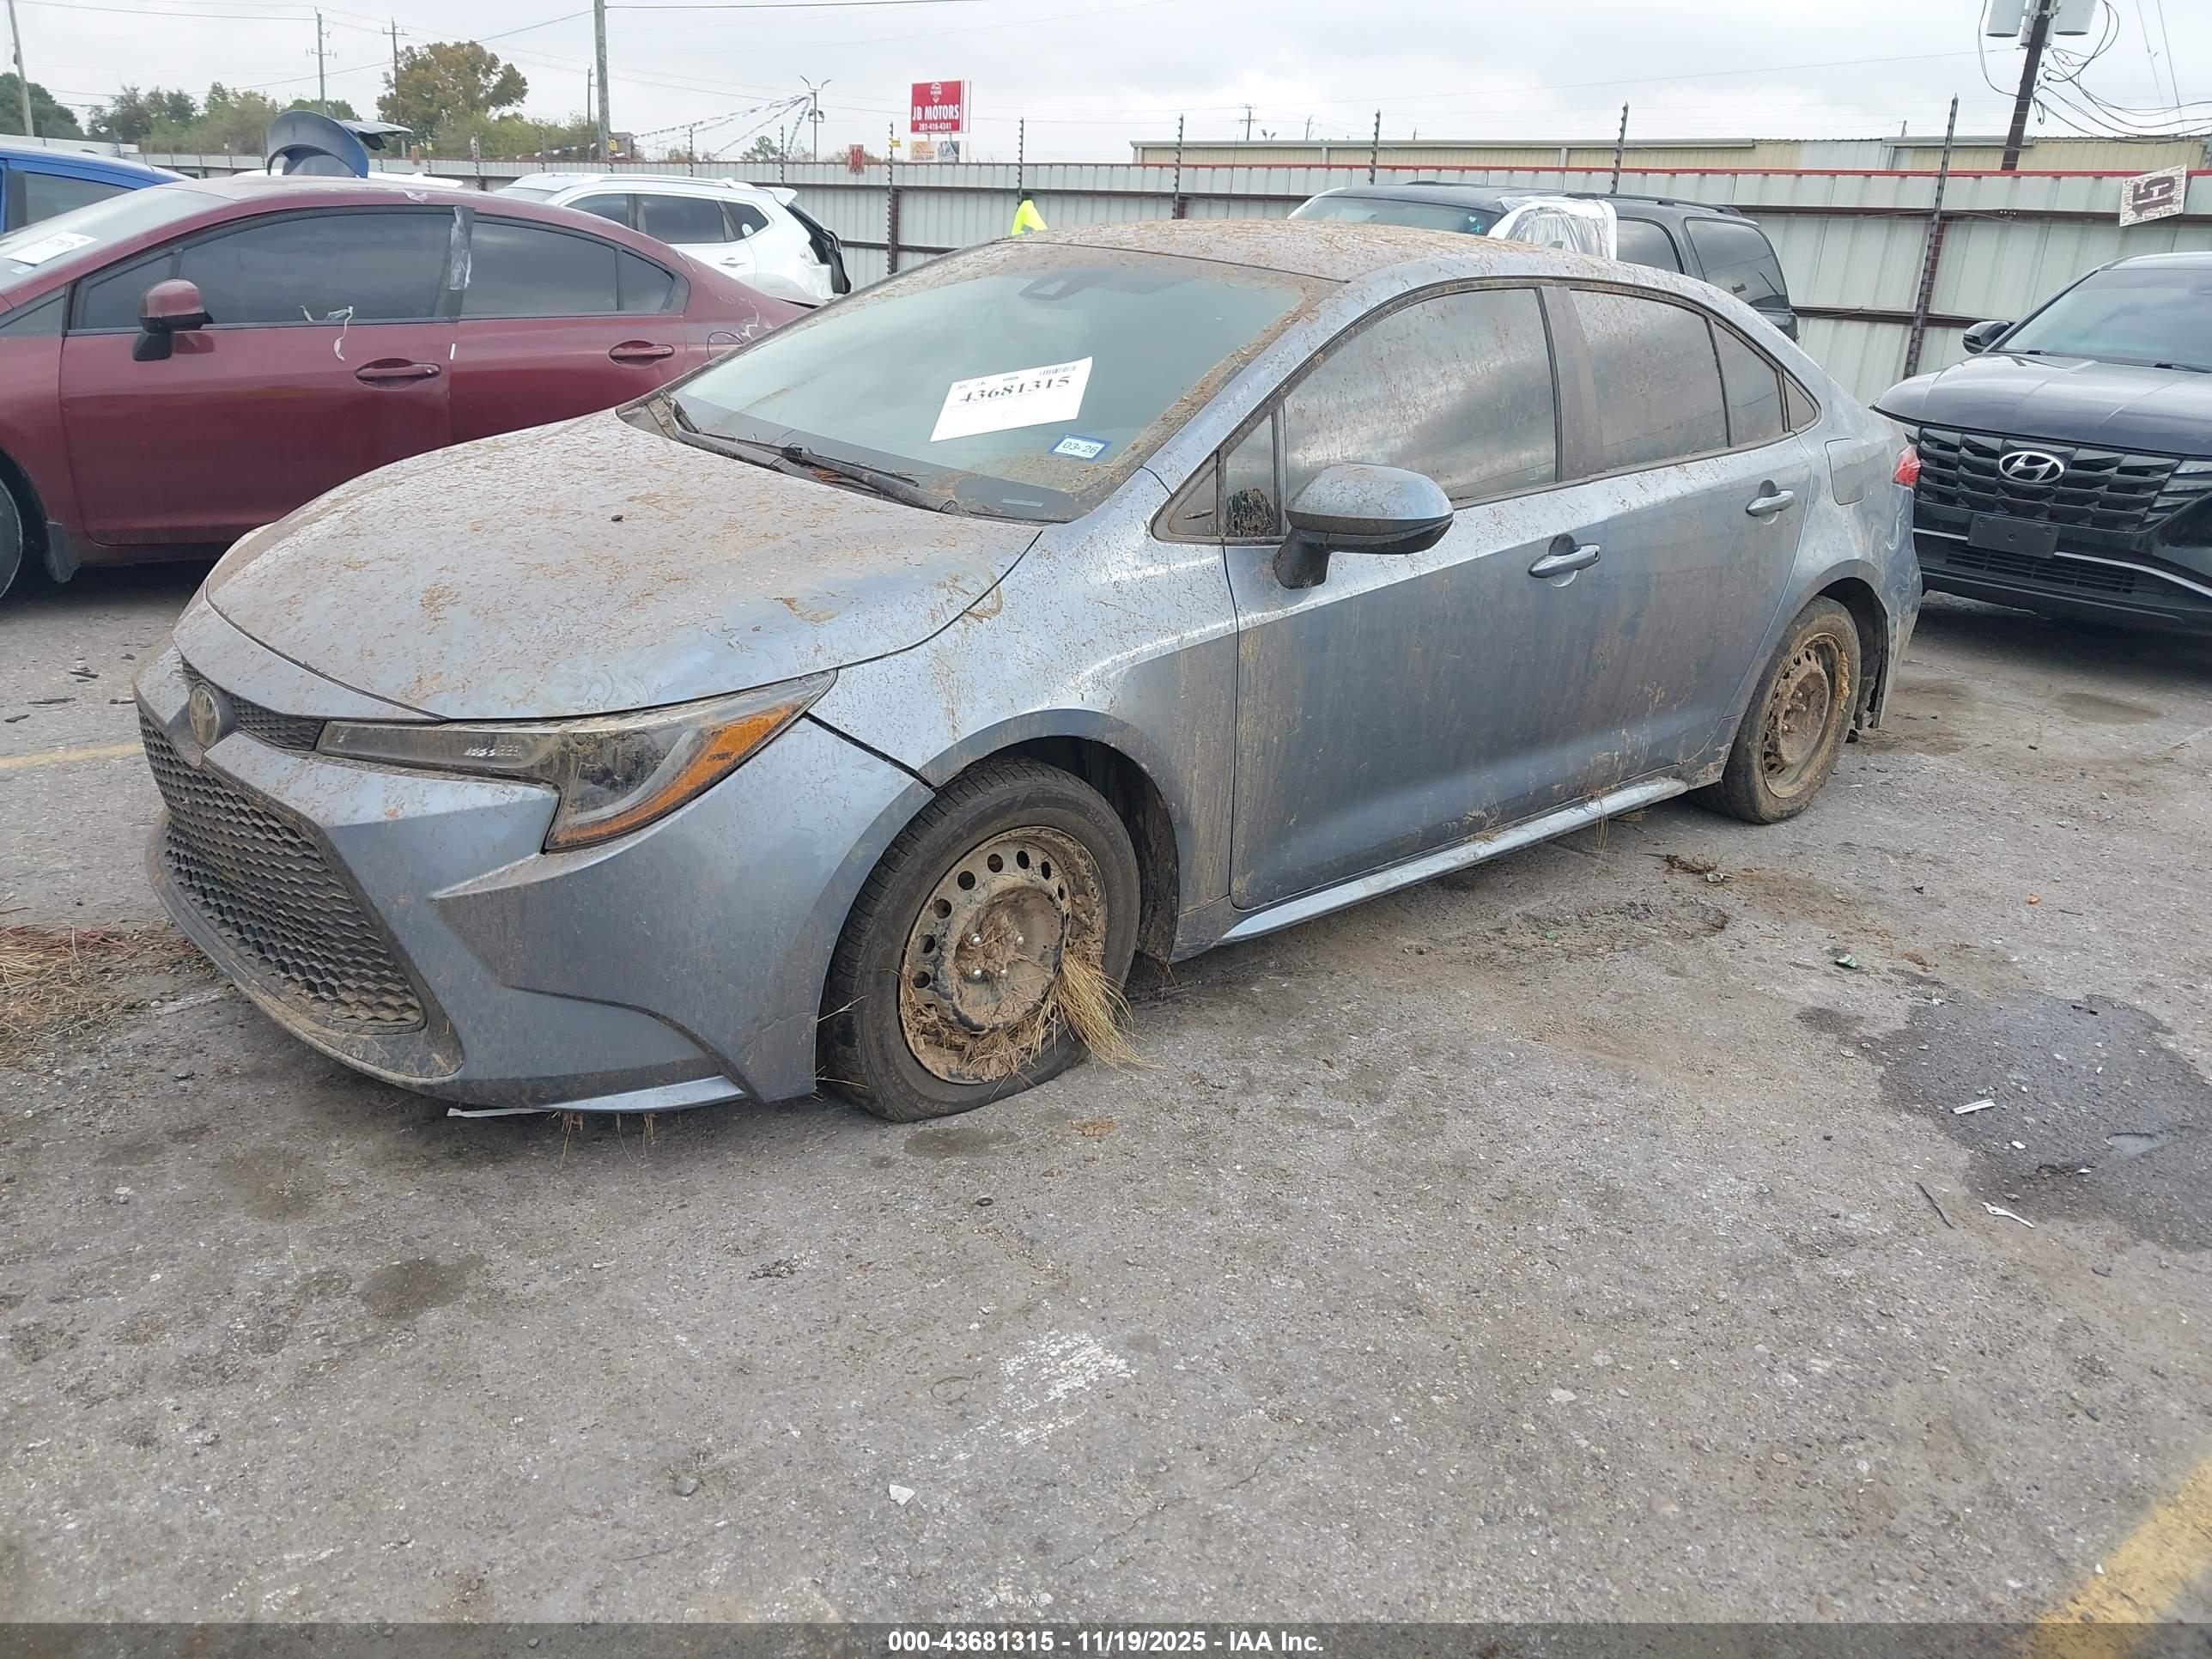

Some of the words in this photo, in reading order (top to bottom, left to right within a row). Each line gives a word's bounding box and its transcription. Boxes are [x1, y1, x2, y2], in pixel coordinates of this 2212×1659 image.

[913, 106, 922, 121] JB
[924, 104, 960, 121] MOTORS
[2131, 176, 2176, 218] 15
[959, 375, 1071, 403] 43681315
